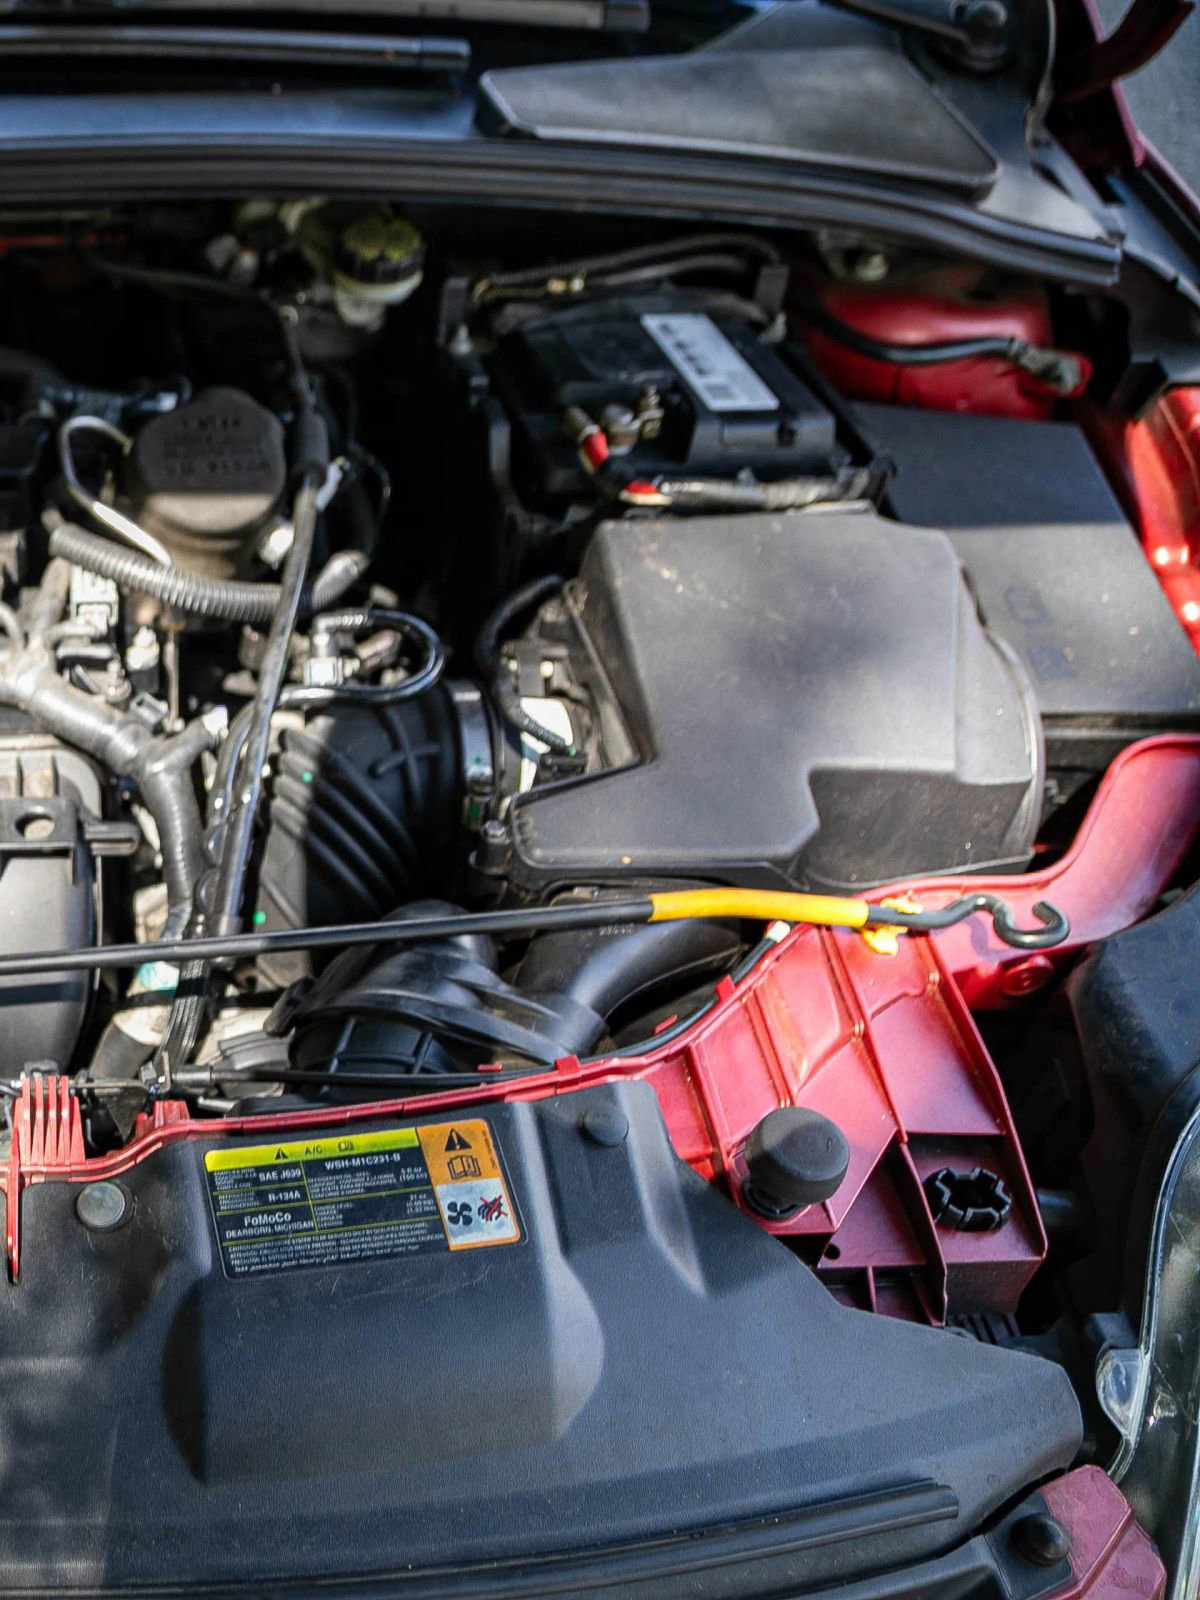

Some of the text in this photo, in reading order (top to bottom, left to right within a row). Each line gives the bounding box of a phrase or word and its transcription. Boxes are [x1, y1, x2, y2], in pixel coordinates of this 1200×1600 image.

[305, 1145, 323, 1155] A/C
[325, 1153, 401, 1170] WSH-M1C231-B
[259, 1171, 279, 1182] SAE
[268, 1190, 301, 1203] R-134A
[244, 1211, 292, 1227] FoMoCo
[275, 1220, 314, 1233] MICHIGAN
